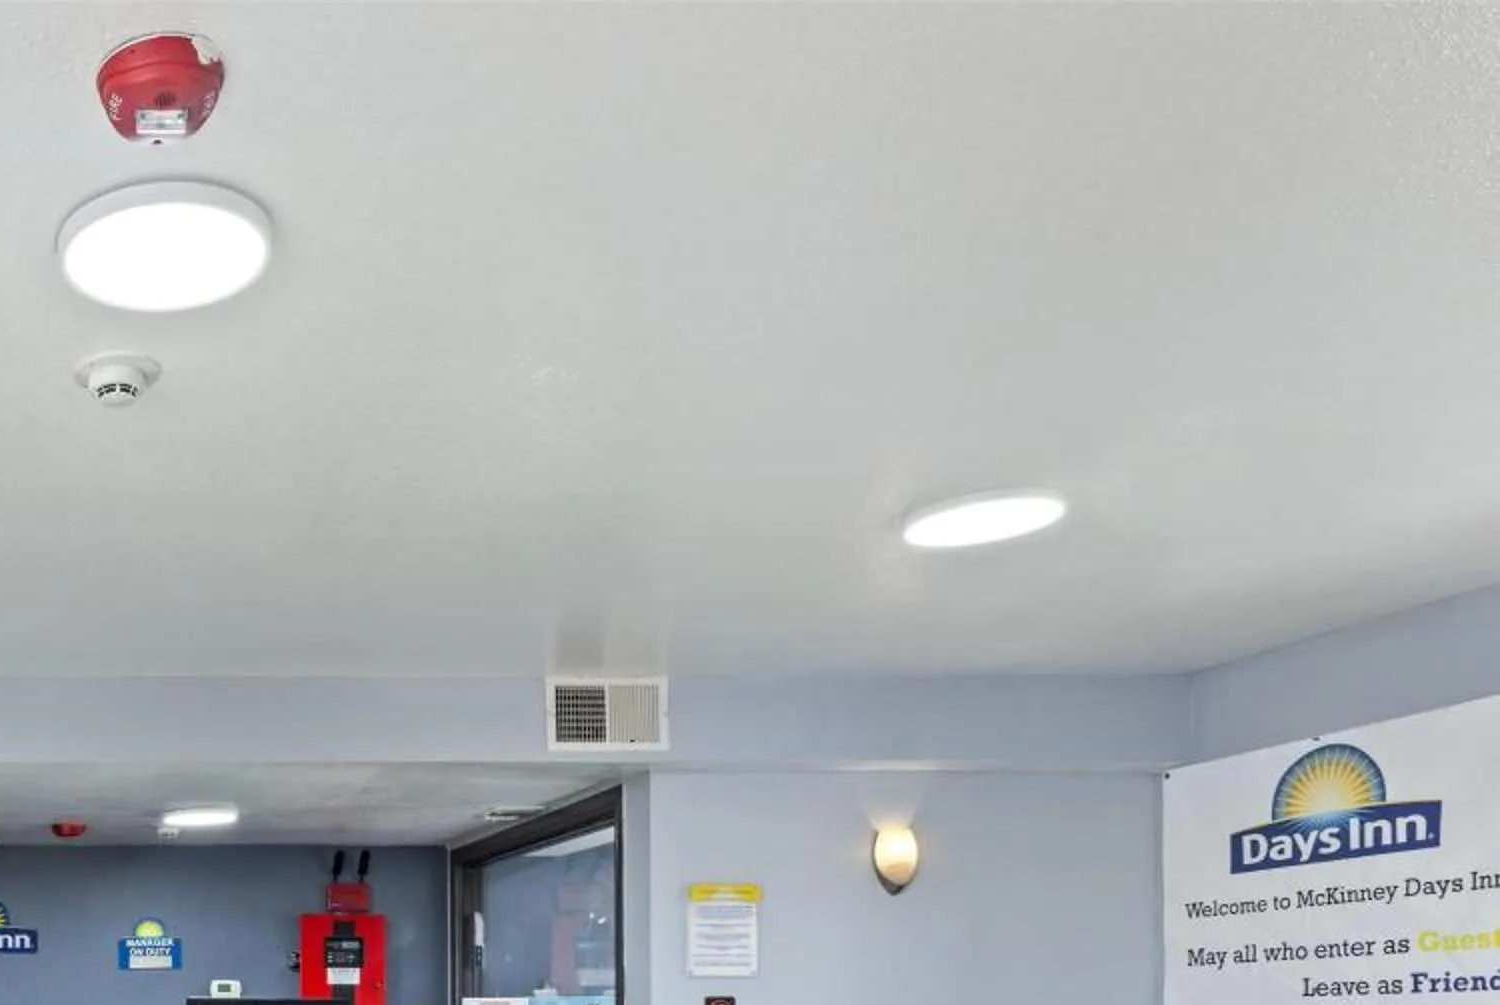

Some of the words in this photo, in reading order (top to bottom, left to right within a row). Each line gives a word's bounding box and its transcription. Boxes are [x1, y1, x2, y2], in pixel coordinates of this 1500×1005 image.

[1241, 827, 1341, 865] Days
[1349, 813, 1428, 851] Inn
[1186, 900, 1267, 919] Welcome
[1273, 896, 1291, 911] to
[1296, 884, 1398, 910] McKinney
[1404, 877, 1464, 899] Days
[1187, 948, 1227, 970] May
[1233, 944, 1257, 963] all
[1264, 940, 1308, 961] who
[1314, 939, 1375, 959] enter
[1383, 937, 1410, 954] as
[1302, 977, 1369, 998] Leave
[1377, 979, 1402, 994] as
